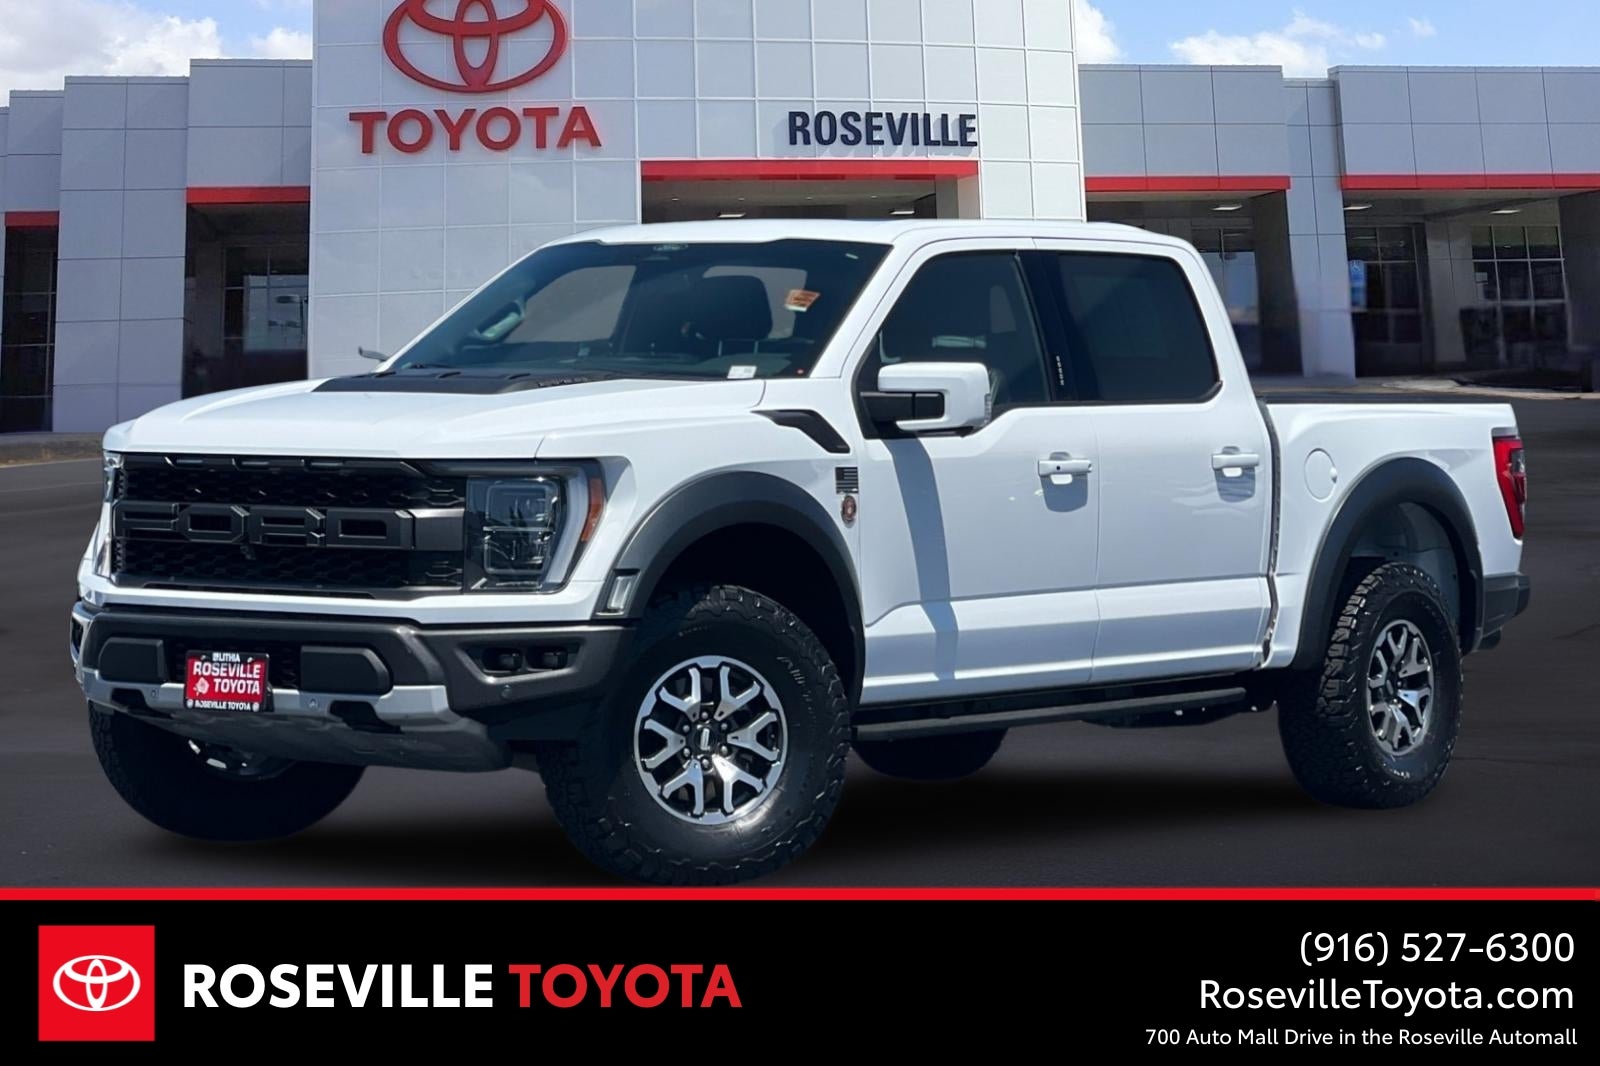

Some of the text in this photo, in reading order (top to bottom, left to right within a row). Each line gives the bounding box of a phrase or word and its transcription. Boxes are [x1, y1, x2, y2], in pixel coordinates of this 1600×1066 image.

[349, 106, 602, 154] TOYOTA
[788, 110, 978, 147] ROSEVILLE
[113, 500, 415, 549] FORD
[193, 661, 262, 679] ROSEVILLE
[213, 678, 260, 695] TOYOTA
[194, 699, 251, 711] ROSEVILLE TOYOTA
